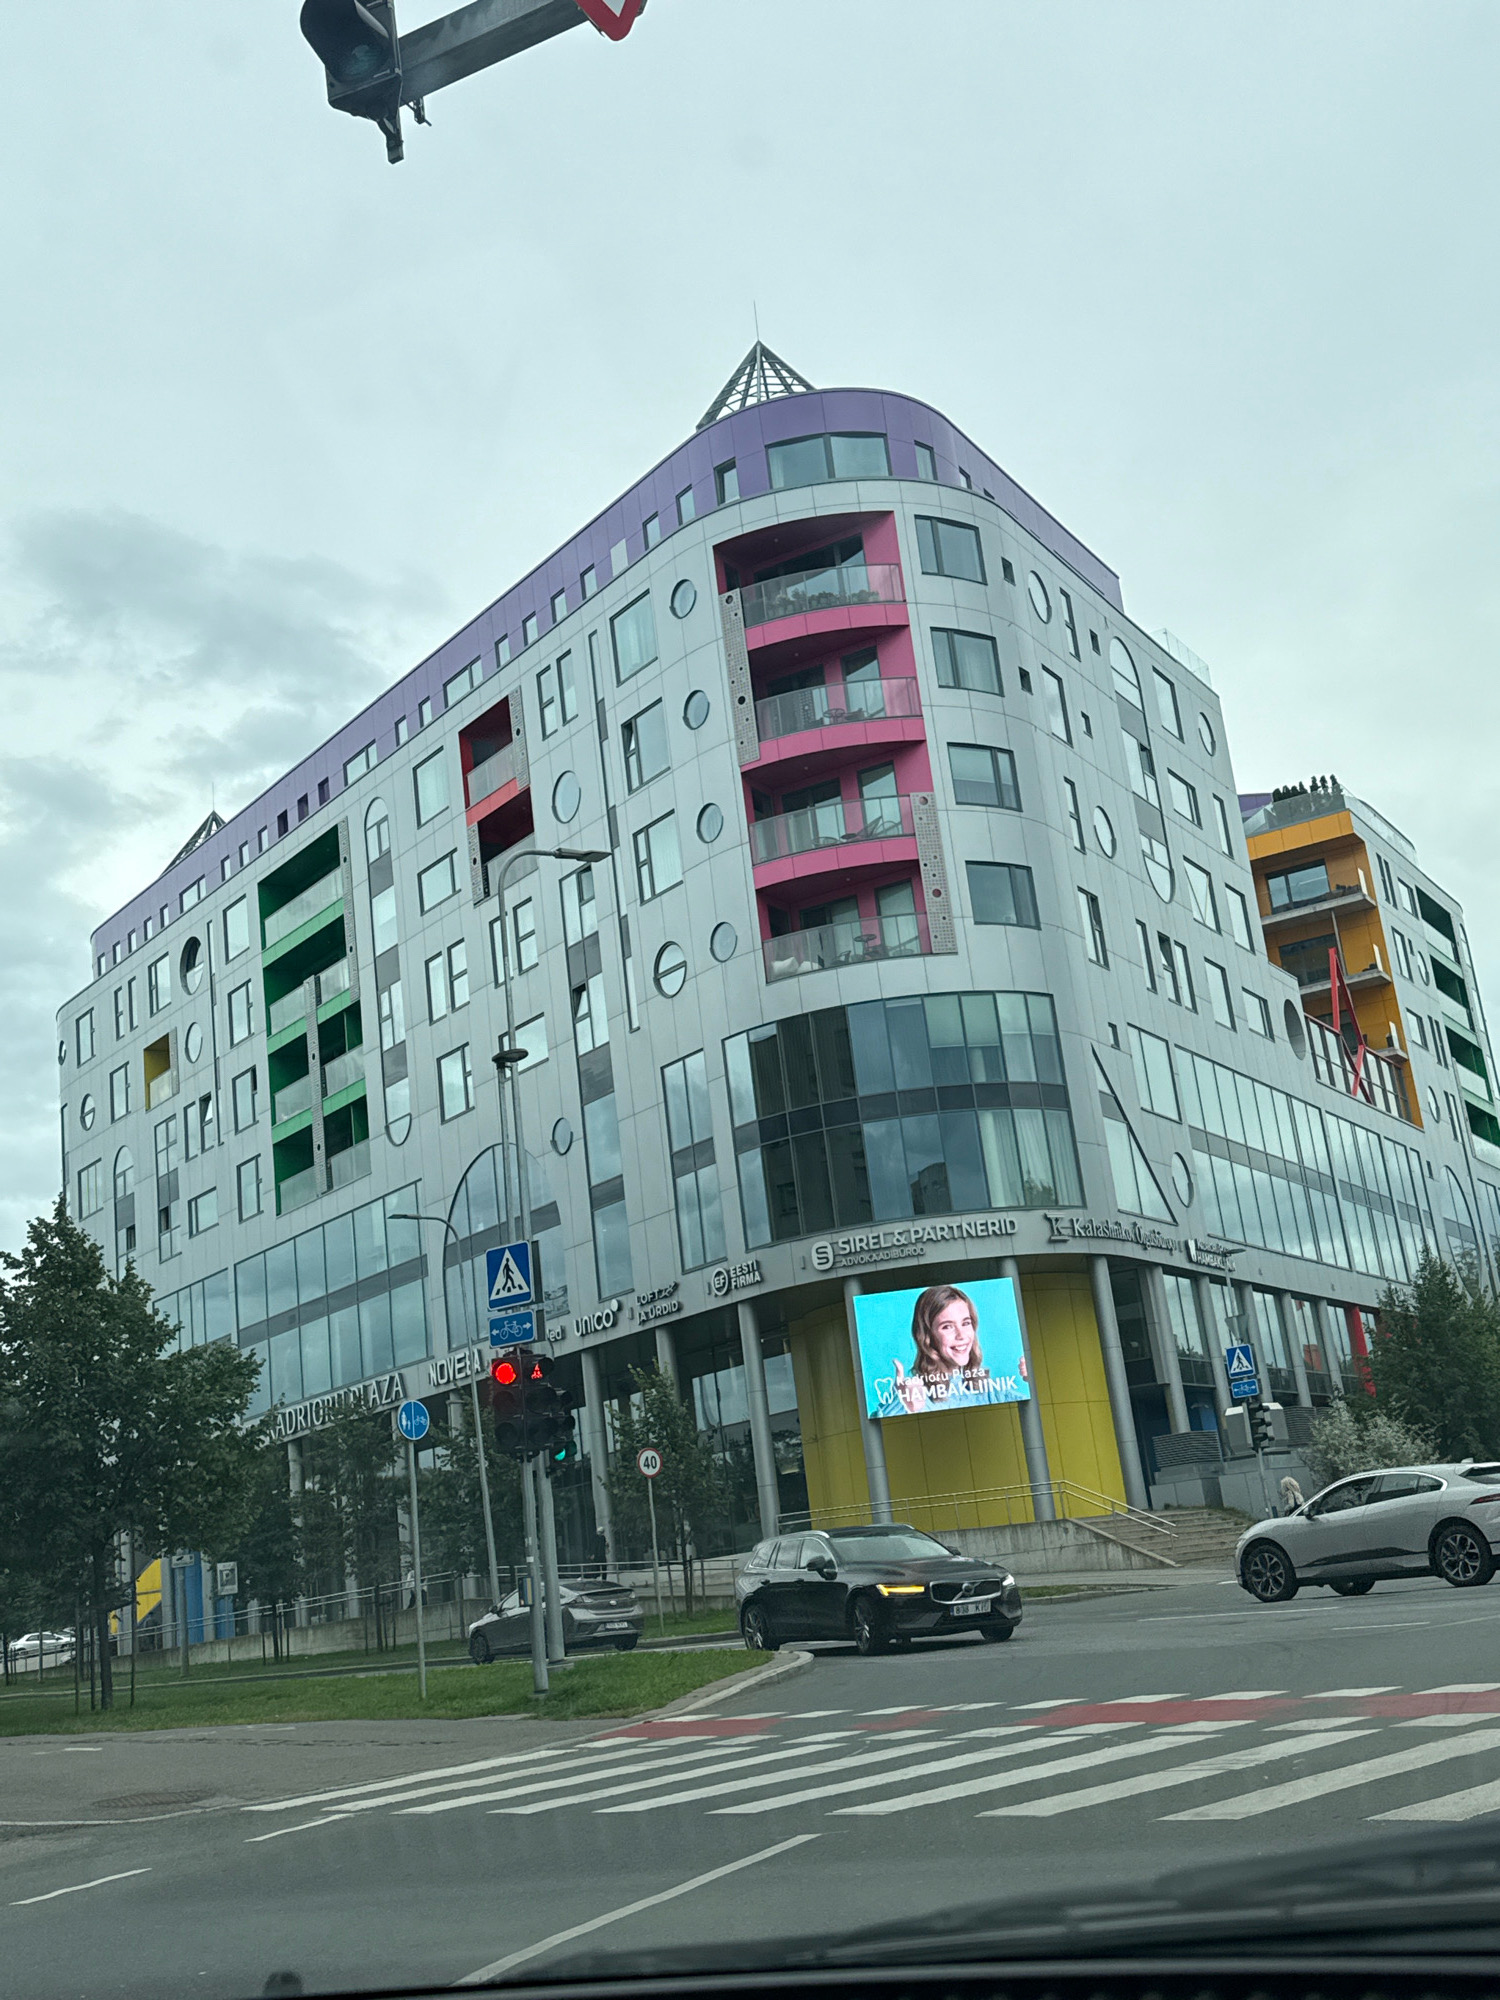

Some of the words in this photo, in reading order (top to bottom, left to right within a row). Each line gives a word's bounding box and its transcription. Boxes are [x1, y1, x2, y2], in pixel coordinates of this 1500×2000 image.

[838, 1233, 892, 1255] SIREL
[893, 1231, 907, 1246] &
[910, 1217, 1019, 1244] PARTNERID
[730, 1260, 757, 1278] EESTI
[731, 1271, 762, 1289] FIRMA
[635, 1289, 659, 1306] LOFT
[573, 1308, 614, 1337] UNICO
[896, 1372, 949, 1386] Kadrioru
[952, 1366, 986, 1379] Plaza
[898, 1375, 1018, 1402] HAMBAKLIINIK
[643, 1455, 657, 1470] 40
